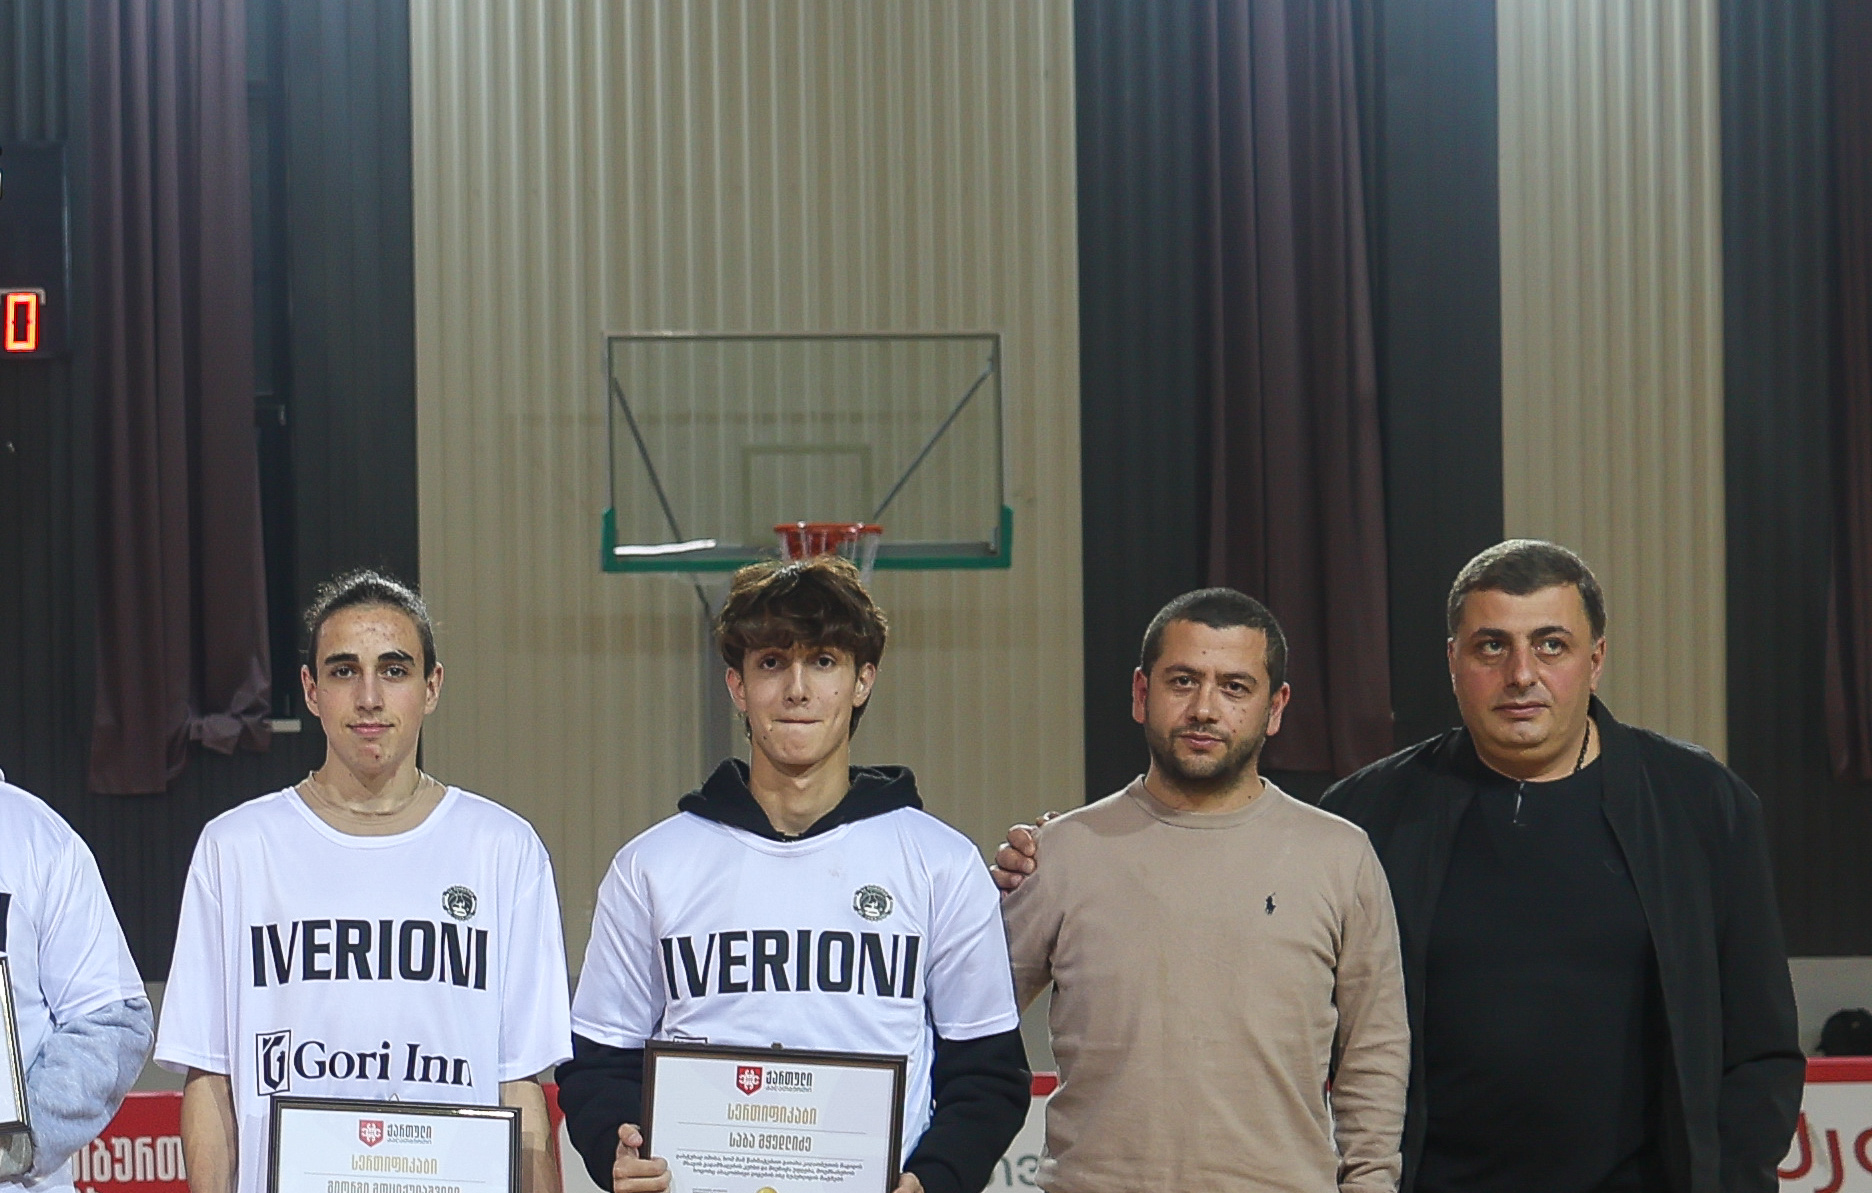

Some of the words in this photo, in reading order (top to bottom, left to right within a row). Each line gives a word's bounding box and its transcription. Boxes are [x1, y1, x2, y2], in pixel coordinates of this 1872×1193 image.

[4, 292, 39, 353] 0
[250, 918, 489, 991] IVERIONI
[659, 929, 921, 1000] IVERIONI
[293, 1040, 391, 1080] Gori
[403, 1043, 473, 1087] Inn
